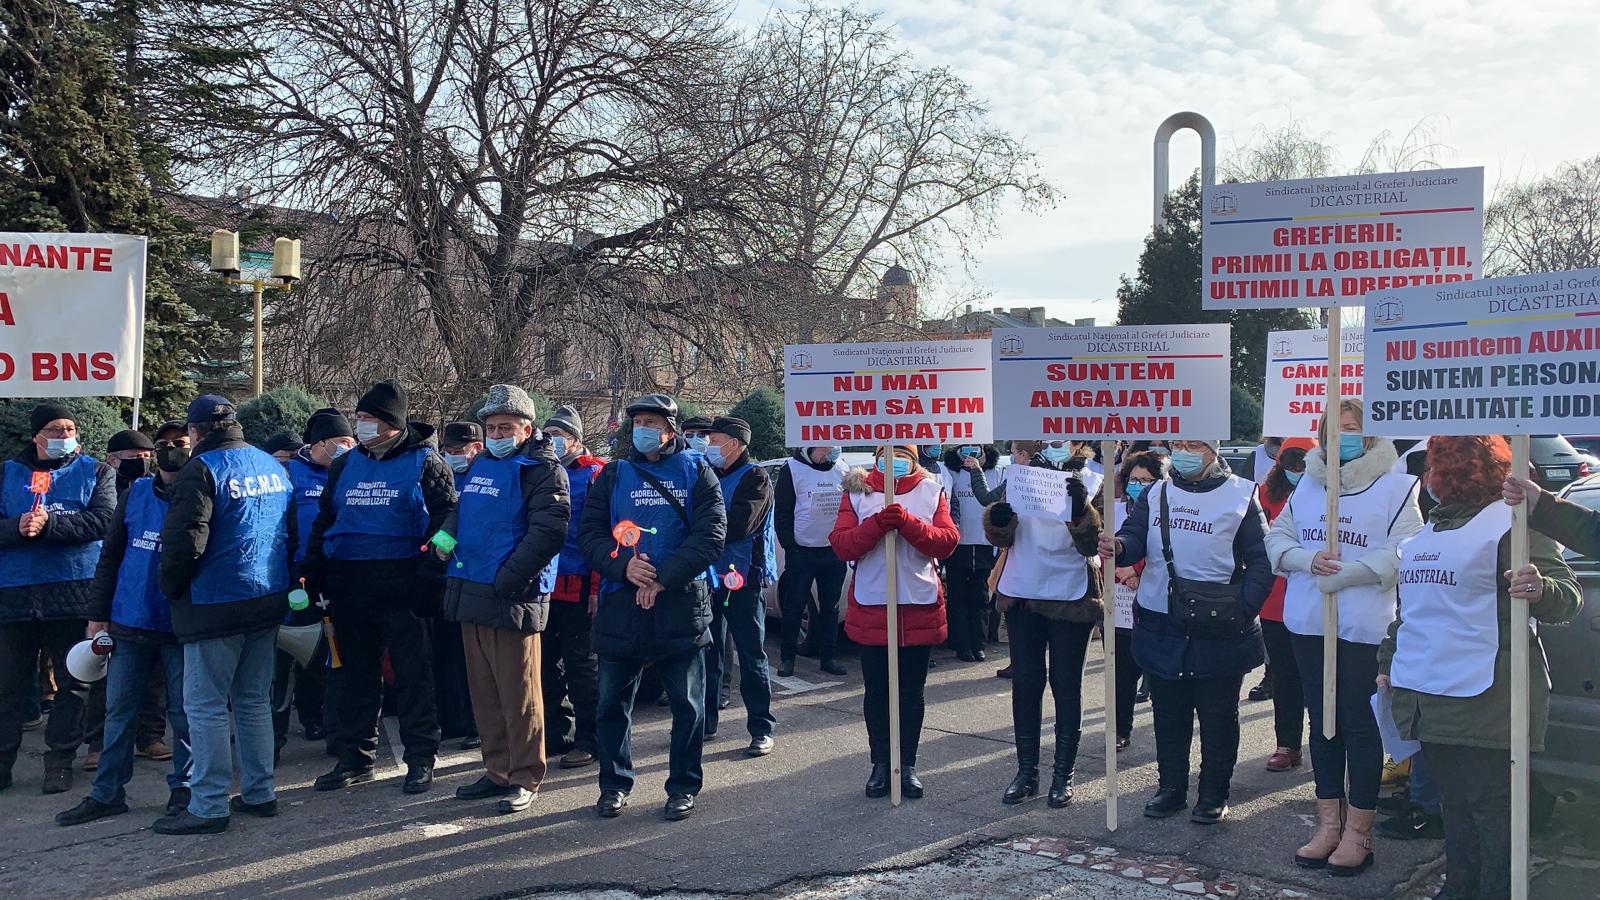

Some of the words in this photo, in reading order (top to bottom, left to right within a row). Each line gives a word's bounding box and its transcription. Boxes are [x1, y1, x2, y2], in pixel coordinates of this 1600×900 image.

[1265, 185, 1313, 196] Sindicatul
[1316, 181, 1359, 194] Național
[1362, 181, 1371, 190] al
[1374, 178, 1405, 189] Grefei
[1409, 177, 1458, 188] Judiciare
[1310, 191, 1408, 208] DICASTERIAL
[1273, 222, 1402, 247] GREFIERII:
[0, 243, 113, 272] NANTE
[1211, 253, 1291, 275] PRIMII
[1299, 252, 1329, 272] LA
[1333, 246, 1473, 272] OBLIGAȚII,
[1210, 279, 1299, 300] ULTIMII
[1306, 278, 1335, 298] LA
[1435, 286, 1493, 302] Sindicatul
[1496, 280, 1549, 297] Național
[1552, 279, 1563, 291] al
[1048, 332, 1090, 341] Sindicatul
[1092, 331, 1129, 342] Național
[1131, 330, 1139, 339] al
[1141, 331, 1168, 339] Grefei
[1170, 330, 1210, 339] Judiciare
[832, 348, 869, 356] Sindicatul
[872, 347, 904, 357] Național
[914, 346, 937, 354] Grefei
[939, 345, 974, 353] Judiciare
[1087, 341, 1170, 353] DICASTERIAL
[1386, 340, 1417, 361] NU
[1423, 335, 1522, 360] suntem
[32, 352, 116, 381] BNS
[867, 356, 939, 367] DICASTERIAL
[1046, 362, 1175, 381] SUNTEM
[833, 375, 873, 392] NU
[882, 374, 938, 391] MAI
[1386, 366, 1483, 391] SUNTEM
[1490, 361, 1600, 388] PERSON
[795, 399, 877, 417] VREM
[886, 395, 924, 415] SĂ
[931, 397, 984, 414] FIM
[1030, 389, 1192, 412] ANGAJAȚII
[1289, 401, 1328, 414] SAL
[1371, 396, 1534, 422] SPECIALITATE
[801, 422, 974, 443] INGNORAȚI!
[1042, 413, 1180, 434] NIMĂNUI
[229, 474, 286, 499] S.C.M.D.
[1152, 516, 1214, 534] DASTERIAL
[1302, 528, 1368, 547] DICASERIAL
